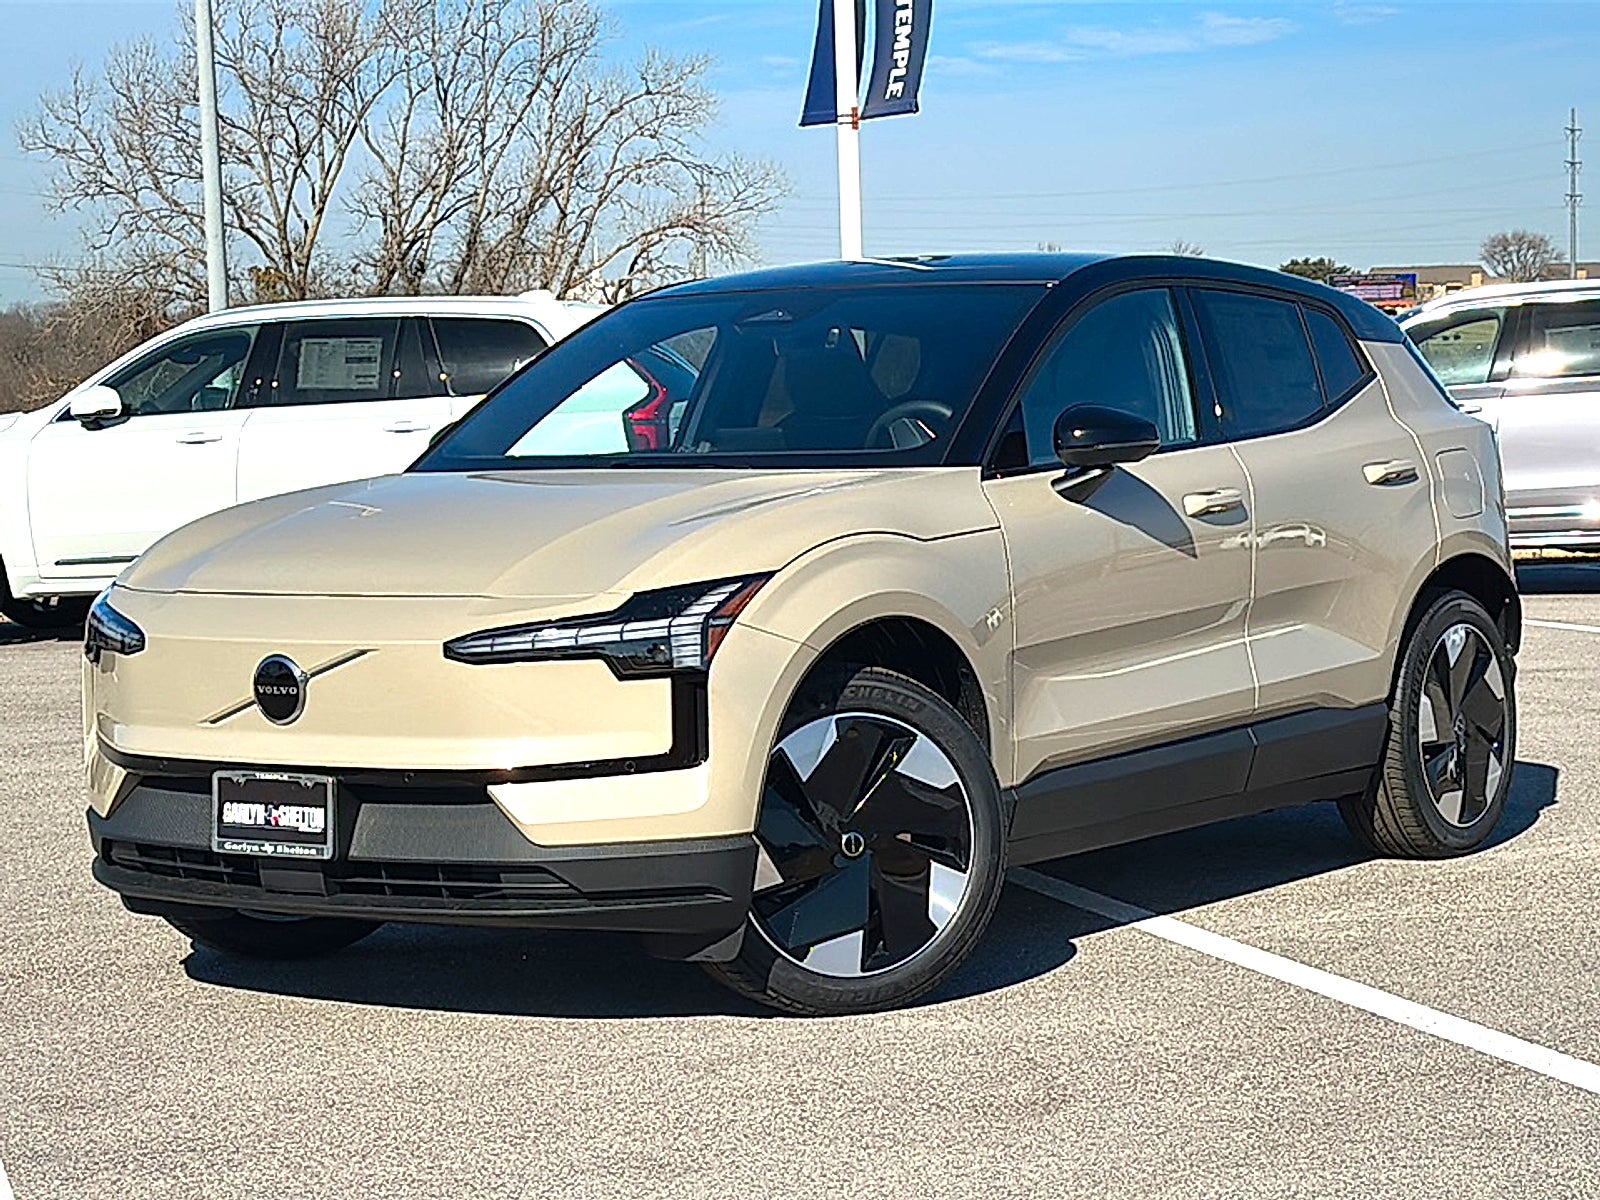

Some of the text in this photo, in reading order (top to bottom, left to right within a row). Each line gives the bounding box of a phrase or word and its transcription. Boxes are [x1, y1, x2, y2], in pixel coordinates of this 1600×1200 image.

[884, 0, 912, 99] TEMPLE
[257, 685, 297, 695] VOLVO
[279, 805, 325, 829] SHELTON
[224, 842, 317, 855] Garlyn Shelton
